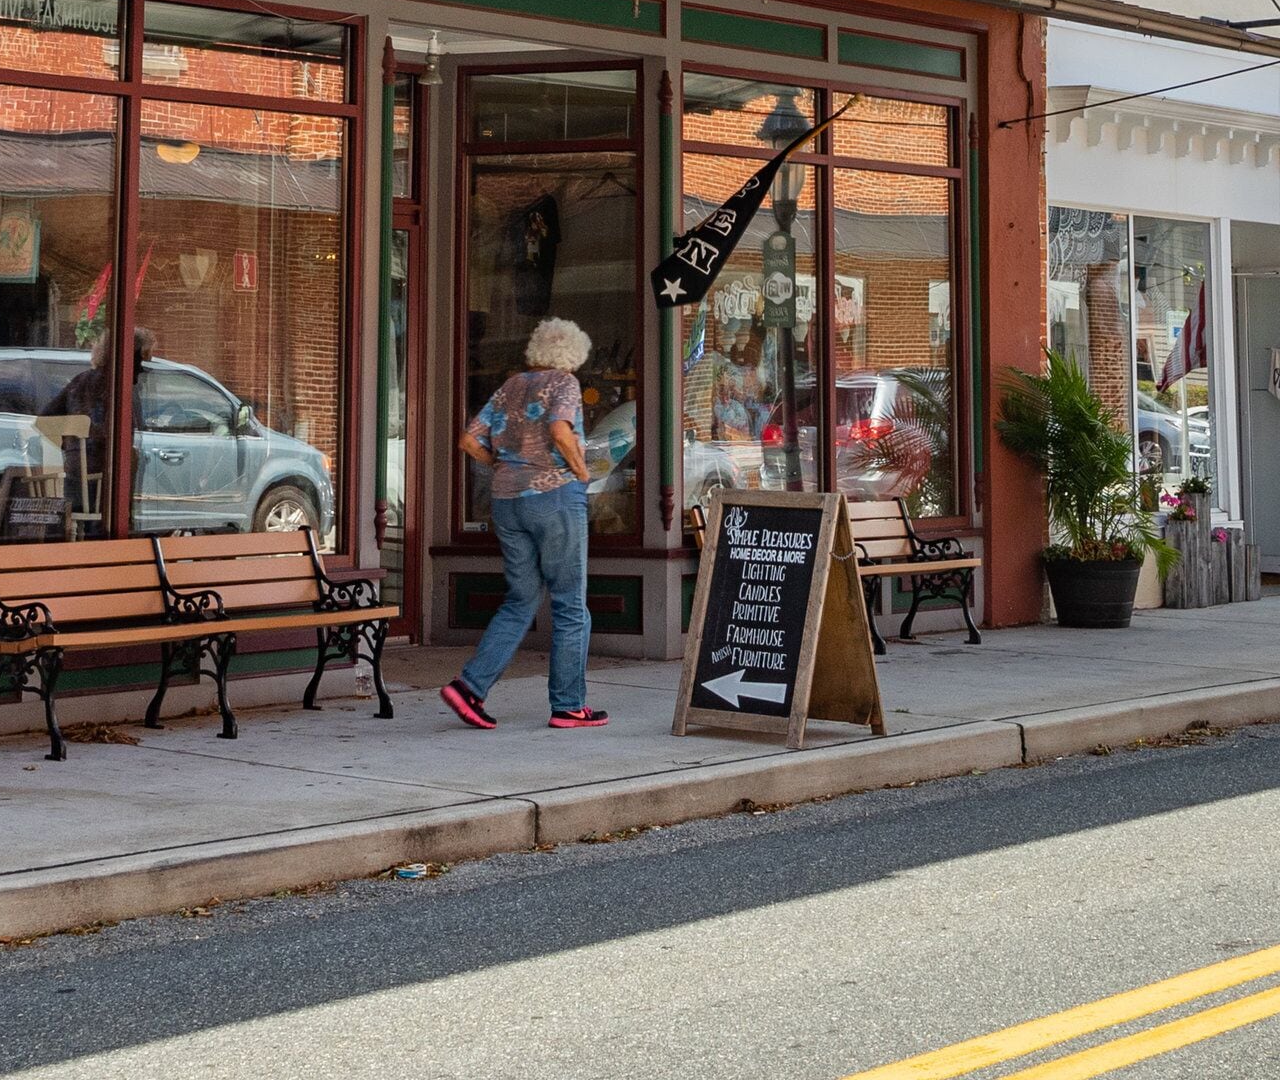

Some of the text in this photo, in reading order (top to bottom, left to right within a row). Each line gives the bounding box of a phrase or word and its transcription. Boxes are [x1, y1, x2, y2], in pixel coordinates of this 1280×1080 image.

[727, 528, 813, 550] SIMPLE PLEASURES
[730, 547, 806, 564] HOME DECOR & MORE
[742, 561, 787, 582] LIGHTING
[739, 582, 782, 602] CANDLES
[732, 601, 781, 623] PRIMITIVE
[726, 624, 785, 647] FARMHOUSE
[711, 645, 787, 670] AMISH FURNITURE
